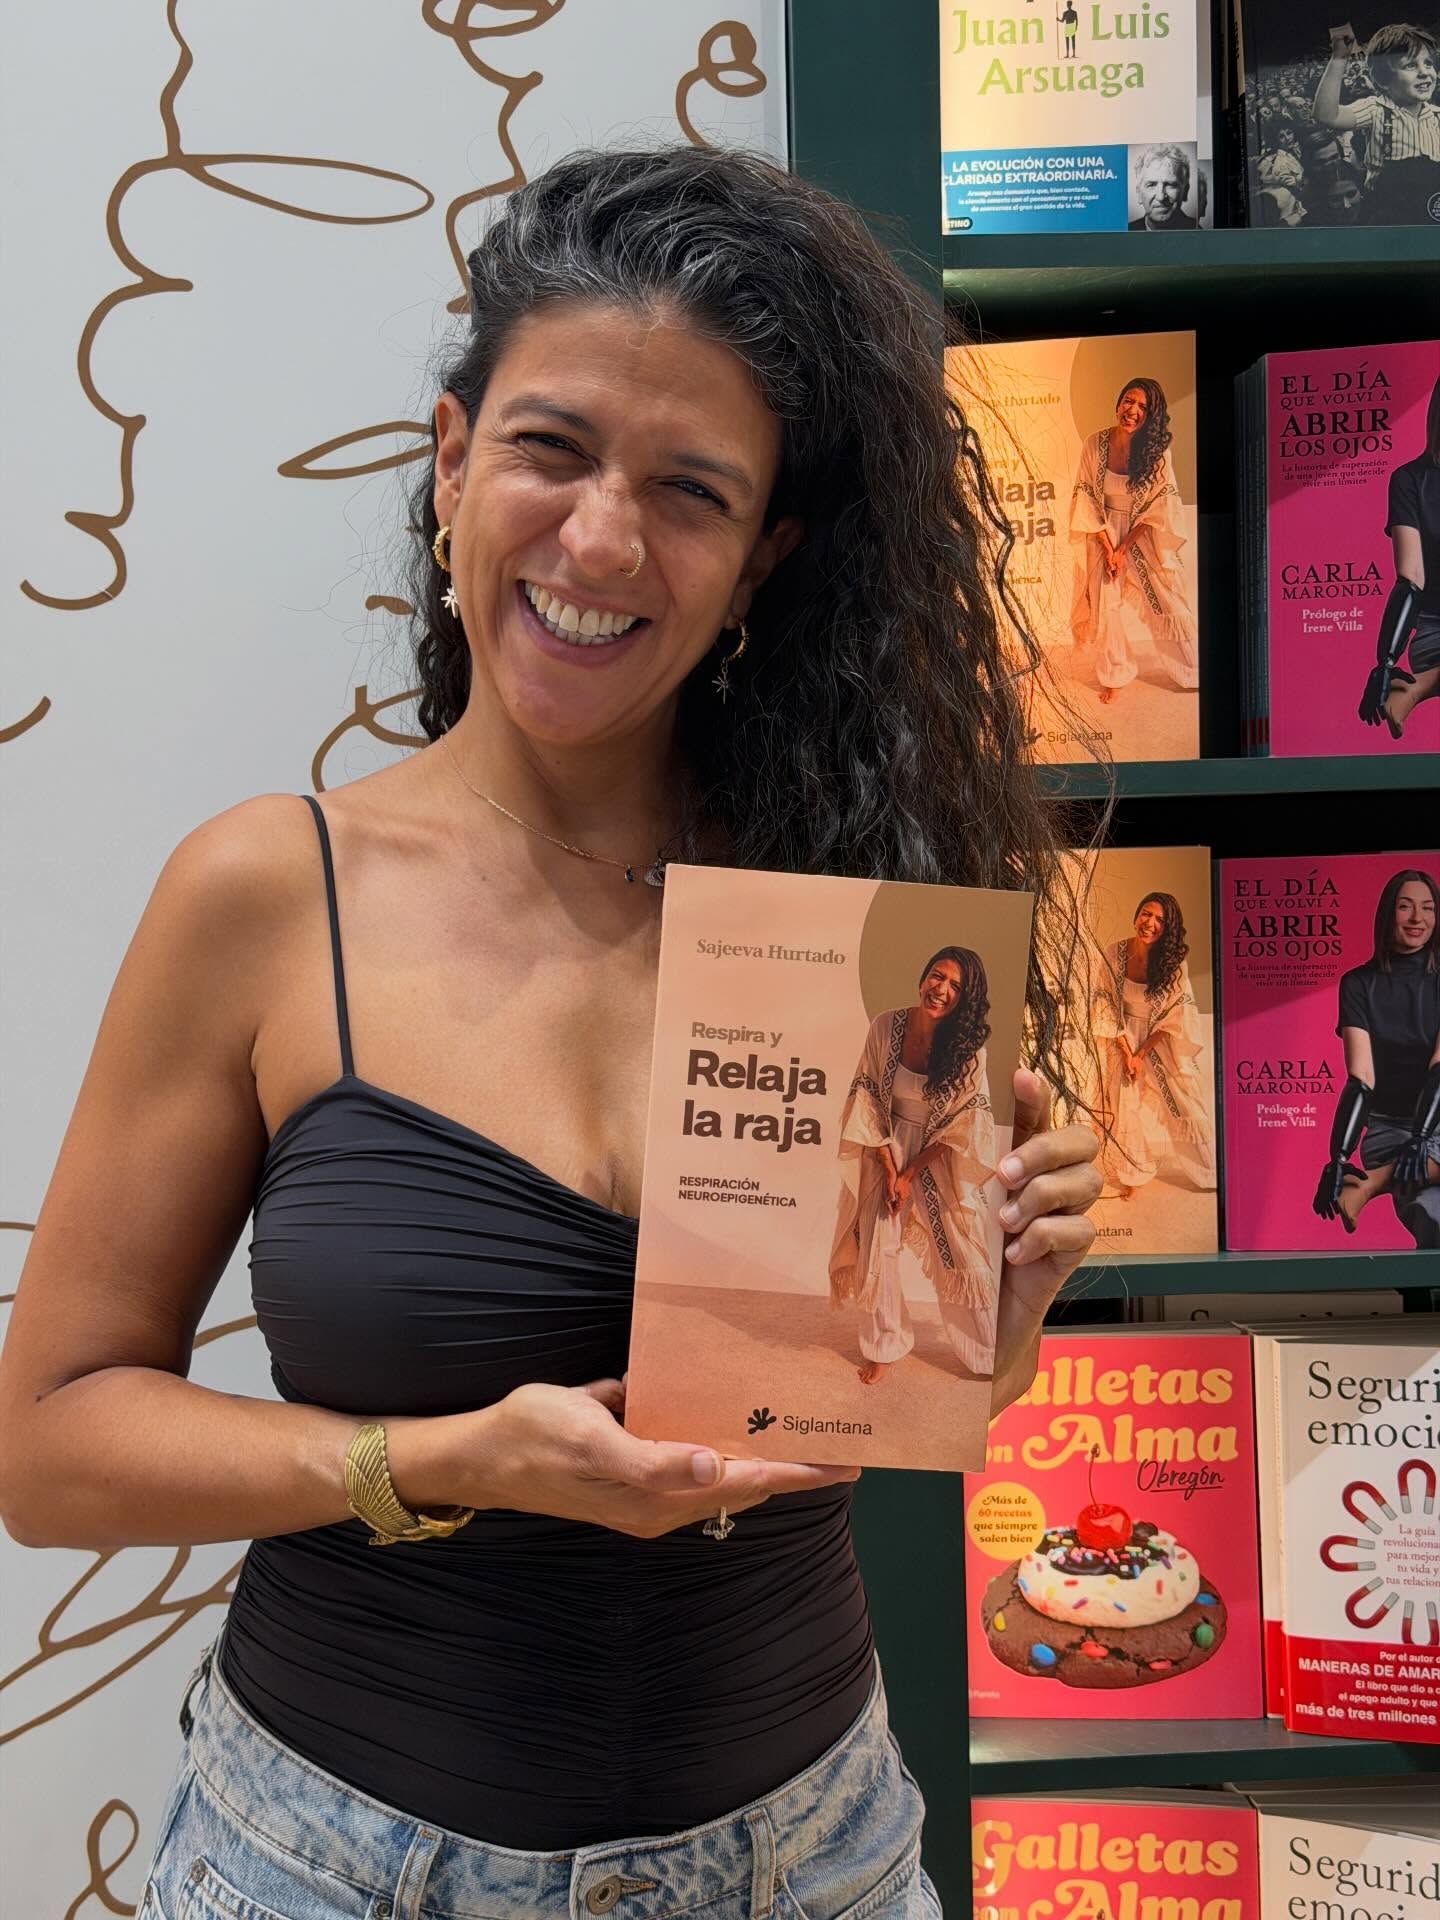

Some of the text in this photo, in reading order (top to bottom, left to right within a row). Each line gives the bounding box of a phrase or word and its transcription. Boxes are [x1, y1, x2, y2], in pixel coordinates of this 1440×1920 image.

[952, 2, 1170, 54] Juan Luis
[977, 58, 1145, 98] Arsuaga
[952, 156, 1105, 172] LA EVOLUCIÓN CON UNA
[1005, 168, 1118, 183] EXTRAORDINARIA.
[1280, 361, 1392, 395] EL DÍA
[1280, 394, 1315, 411] QUE
[1380, 391, 1392, 401] A
[1280, 408, 1392, 437] ABRIR
[1280, 435, 1393, 459] LOS OJOS
[1329, 461, 1340, 470] de
[1340, 470, 1356, 480] que
[997, 476, 1056, 509] laja
[1010, 512, 1056, 546] aja
[1281, 561, 1384, 585] CARLA
[1282, 583, 1383, 600] MARONDA
[1302, 606, 1364, 622] Prólogo de
[1303, 620, 1364, 633] Irene Villa
[1234, 869, 1340, 896] EL DÍA
[1233, 898, 1267, 912] QUE
[1330, 898, 1340, 907] A
[1233, 914, 1342, 938] ABRIR
[696, 938, 846, 965] Sajeeva Hurtado
[1233, 939, 1342, 961] LOS OJOS
[691, 1021, 783, 1048] Respira y
[687, 1049, 827, 1103] Relaja
[1236, 1060, 1335, 1080] CARLA
[1237, 1081, 1335, 1095] MARONDA
[1257, 1103, 1317, 1116] Prólogo de
[682, 1099, 821, 1152] la raja
[1258, 1116, 1316, 1127] Irene Villa
[679, 1176, 760, 1191] RESPIRACIÓN
[678, 1190, 797, 1207] NEUROEPIGENÉTICA
[1016, 1356, 1233, 1406] alletas
[1308, 1360, 1440, 1415] Seguri
[782, 1415, 873, 1435] Siglantana
[1308, 1414, 1440, 1450] emoci
[1022, 1414, 1239, 1470] Alma
[1137, 1459, 1225, 1500] Obregón
[982, 1496, 1028, 1505] Más de
[978, 1508, 1032, 1517] 60 recetas
[974, 1521, 1038, 1531] que siempre
[1400, 1524, 1412, 1534] La
[1010, 1534, 1033, 1543] bien
[1387, 1551, 1409, 1561] para
[1410, 1564, 1430, 1574] vida
[1433, 1567, 1440, 1576] y
[1386, 1577, 1400, 1585] tus
[1380, 1651, 1396, 1661] Por
[1398, 1653, 1407, 1661] el
[1409, 1654, 1433, 1663] autor
[1298, 1658, 1440, 1680] MANERAS DE AMAR
[1355, 1680, 1365, 1689] El
[1367, 1681, 1388, 1691] libro
[1390, 1683, 1408, 1693] que
[1410, 1684, 1425, 1694] dio
[1427, 1686, 1434, 1694] a
[1338, 1692, 1438, 1708] el apego adulto y que
[1296, 1702, 1437, 1725] más de tres millones
[972, 1819, 1239, 1896] Galletas
[1289, 1837, 1440, 1901] Segurid
[1027, 1879, 1242, 1920] Alma
